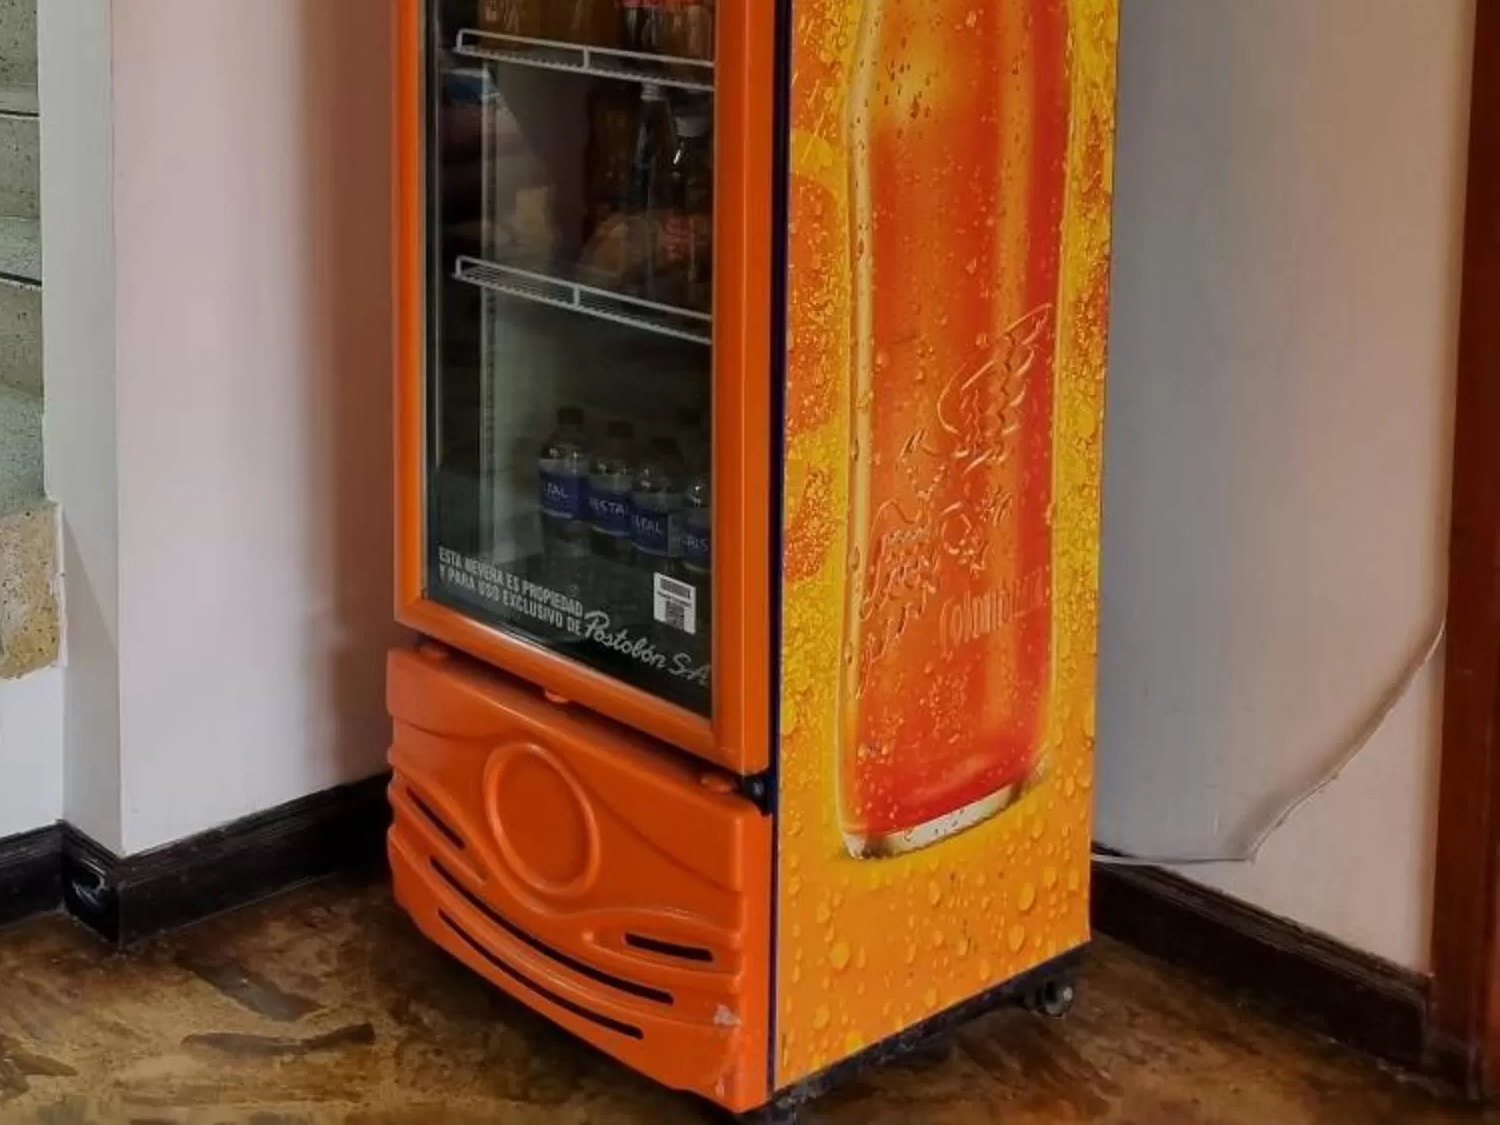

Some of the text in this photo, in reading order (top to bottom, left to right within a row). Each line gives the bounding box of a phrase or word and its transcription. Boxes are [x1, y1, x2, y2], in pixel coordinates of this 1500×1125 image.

[439, 546, 583, 617] ESTA NEVERA ES PROPIEDAD
[447, 566, 476, 592] PARA
[478, 580, 500, 602] USO
[503, 590, 564, 628] EXCLUSIVO
[566, 616, 582, 636] DE
[583, 610, 666, 668] Postobón
